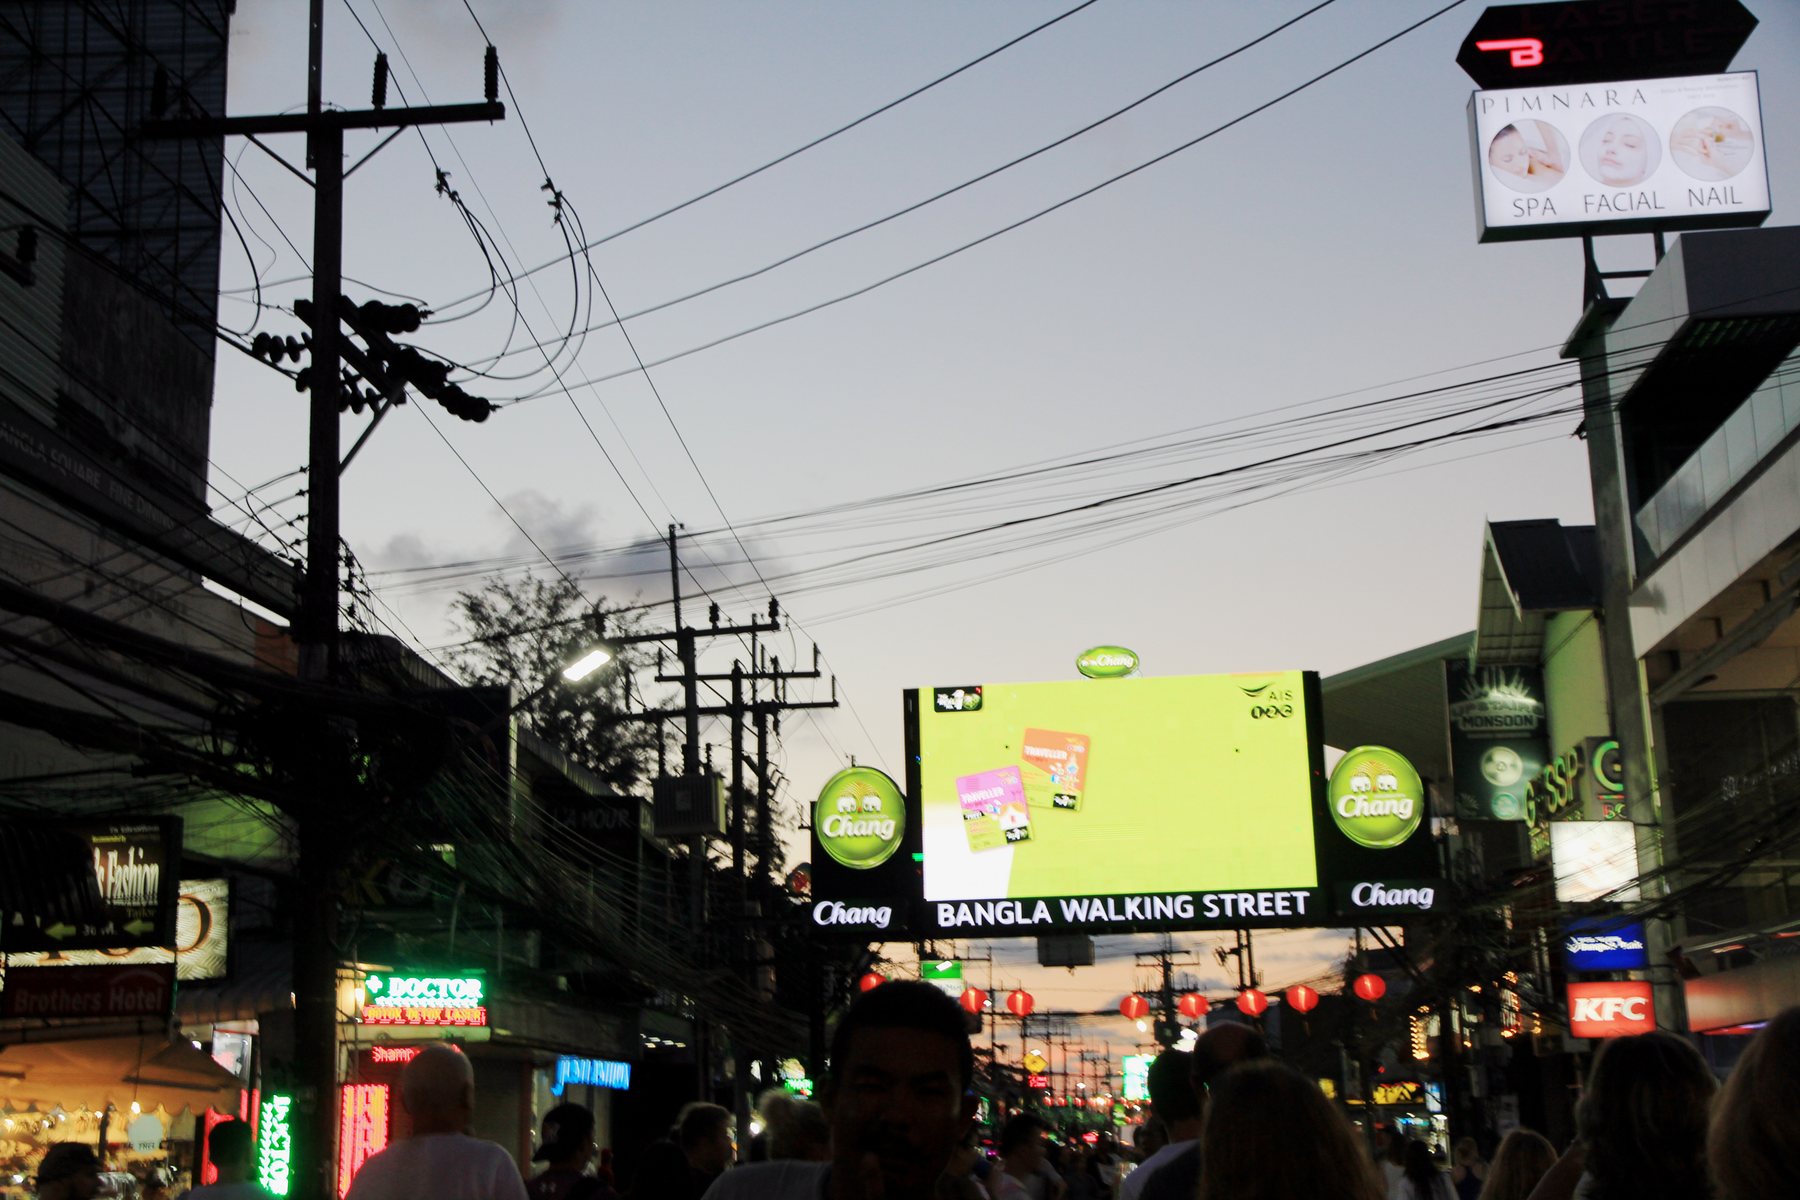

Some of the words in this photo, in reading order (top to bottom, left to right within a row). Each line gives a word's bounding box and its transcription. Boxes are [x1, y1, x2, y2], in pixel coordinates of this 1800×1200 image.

[1519, 0, 1698, 34] LASER
[1482, 89, 1647, 114] PIMNARA
[1513, 197, 1557, 218] SPA
[1584, 191, 1666, 213] FACIAL
[1688, 186, 1743, 207] NAIL
[1096, 653, 1135, 669] Chang
[1462, 714, 1534, 729] MONSOON
[1337, 794, 1415, 820] Chang
[822, 814, 897, 841] Chang
[106, 845, 160, 906] Fashion
[937, 900, 1053, 928] BANGLA
[1059, 894, 1195, 923] WALKING
[1202, 891, 1311, 918] STREET
[1351, 882, 1435, 910] Chang
[813, 900, 893, 929] Chang
[14, 988, 102, 1014] Brothers
[108, 985, 165, 1012] Hotel
[388, 976, 485, 999] DOCTOR
[1572, 996, 1649, 1022] KFC
